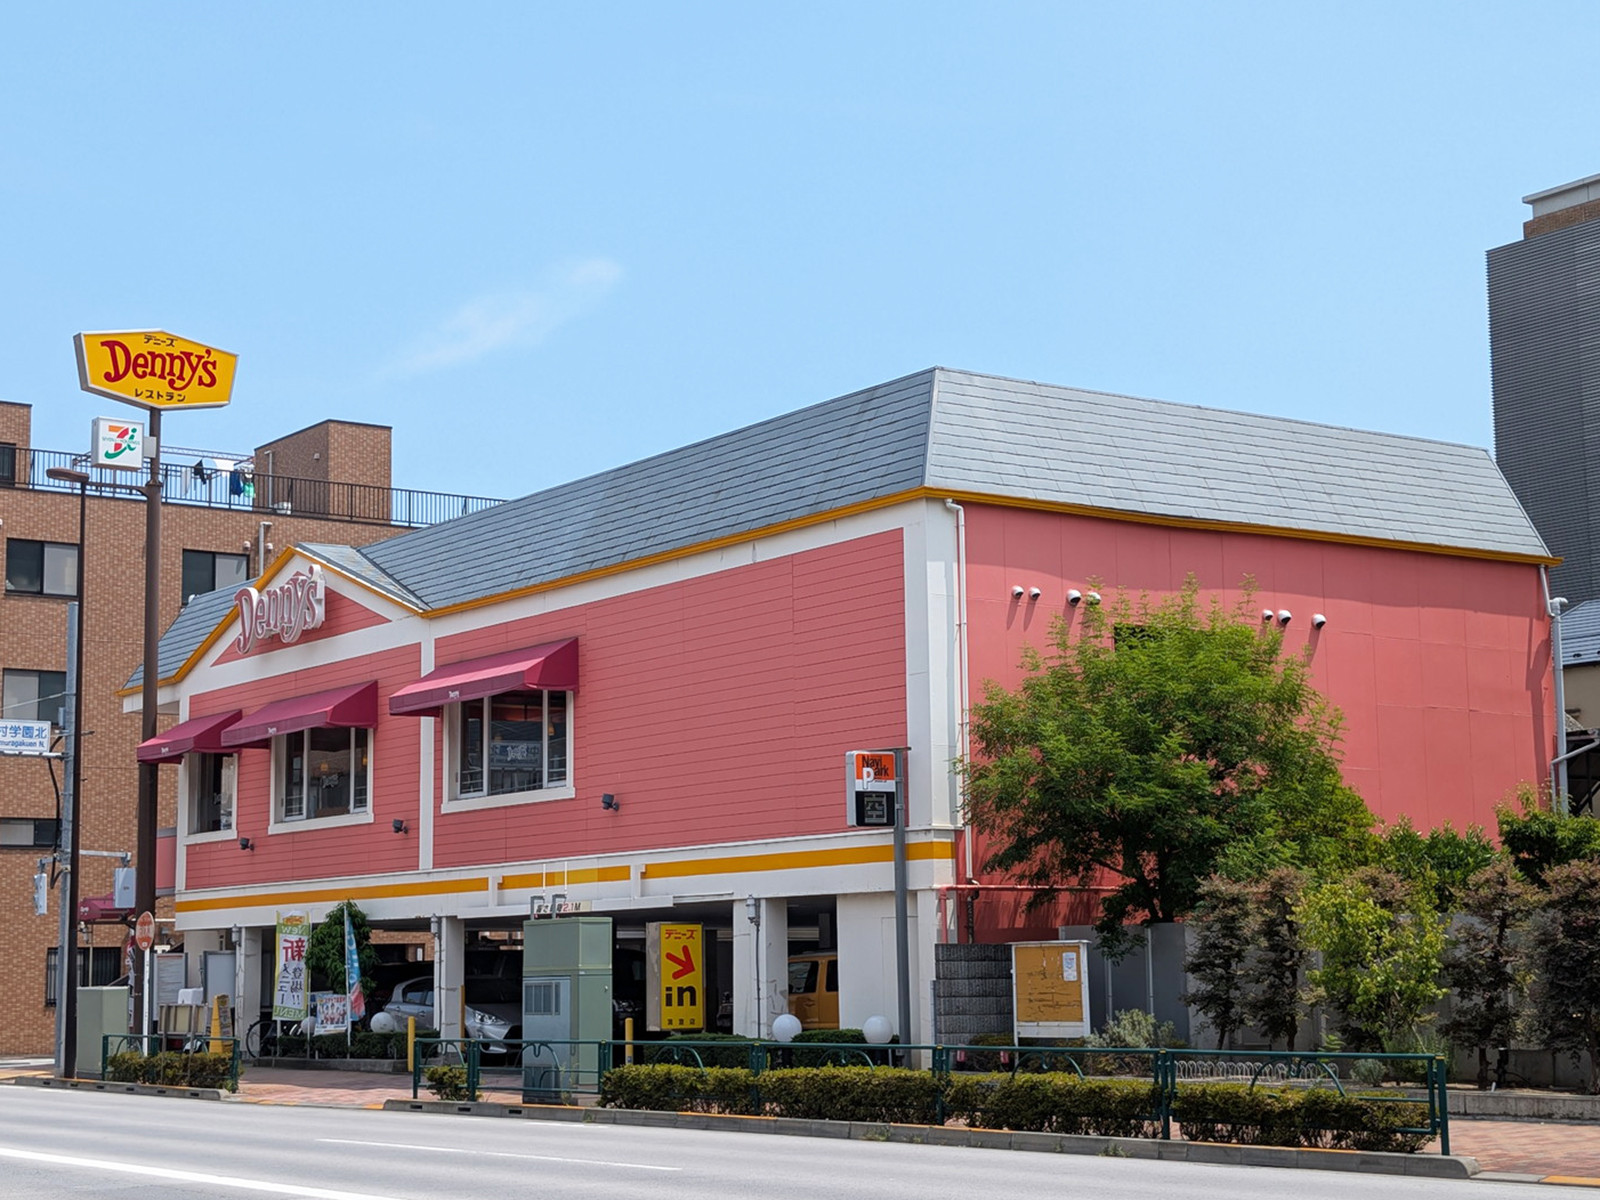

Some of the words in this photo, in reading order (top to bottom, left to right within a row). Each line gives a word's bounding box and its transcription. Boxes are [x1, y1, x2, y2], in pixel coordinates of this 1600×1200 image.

[143, 334, 178, 348] デニーズ
[100, 339, 217, 392] Denny's
[134, 388, 186, 402] レストラン
[233, 564, 319, 655] Denny's
[862, 754, 883, 768] Navi
[862, 764, 889, 790] Park
[665, 929, 697, 940] デニーズ
[665, 985, 697, 1007] in
